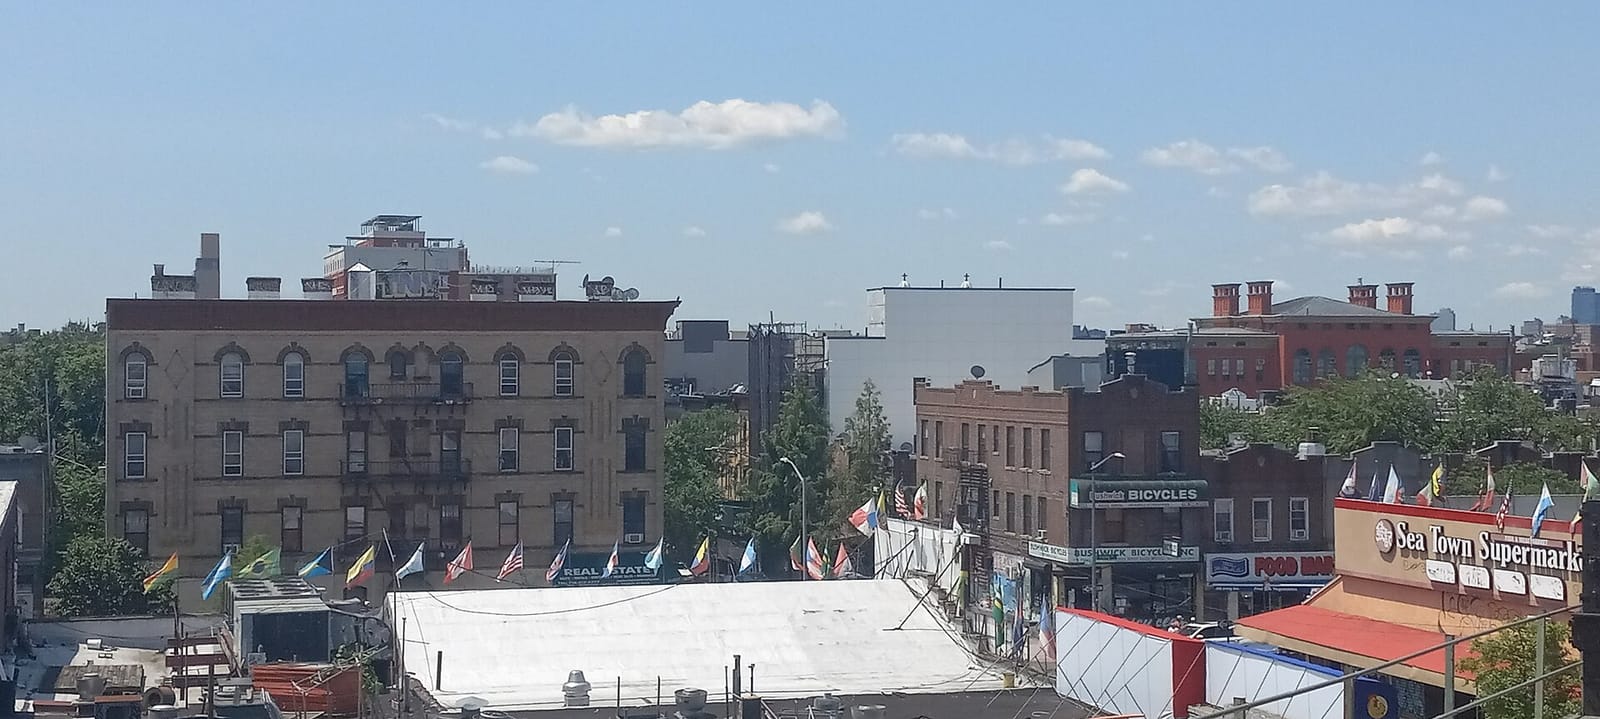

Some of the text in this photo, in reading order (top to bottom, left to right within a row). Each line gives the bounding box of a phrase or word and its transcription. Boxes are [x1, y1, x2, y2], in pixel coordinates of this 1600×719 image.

[1128, 489, 1198, 500] BICYCLES
[1397, 521, 1425, 551] Sea
[1429, 525, 1472, 557] Town
[1479, 531, 1583, 571] Supermark
[1131, 548, 1163, 556] BICYCL
[1179, 548, 1194, 556] NC
[564, 566, 651, 576] REAL STATE
[1254, 556, 1298, 577] FOOD
[1301, 556, 1335, 577] MAR
